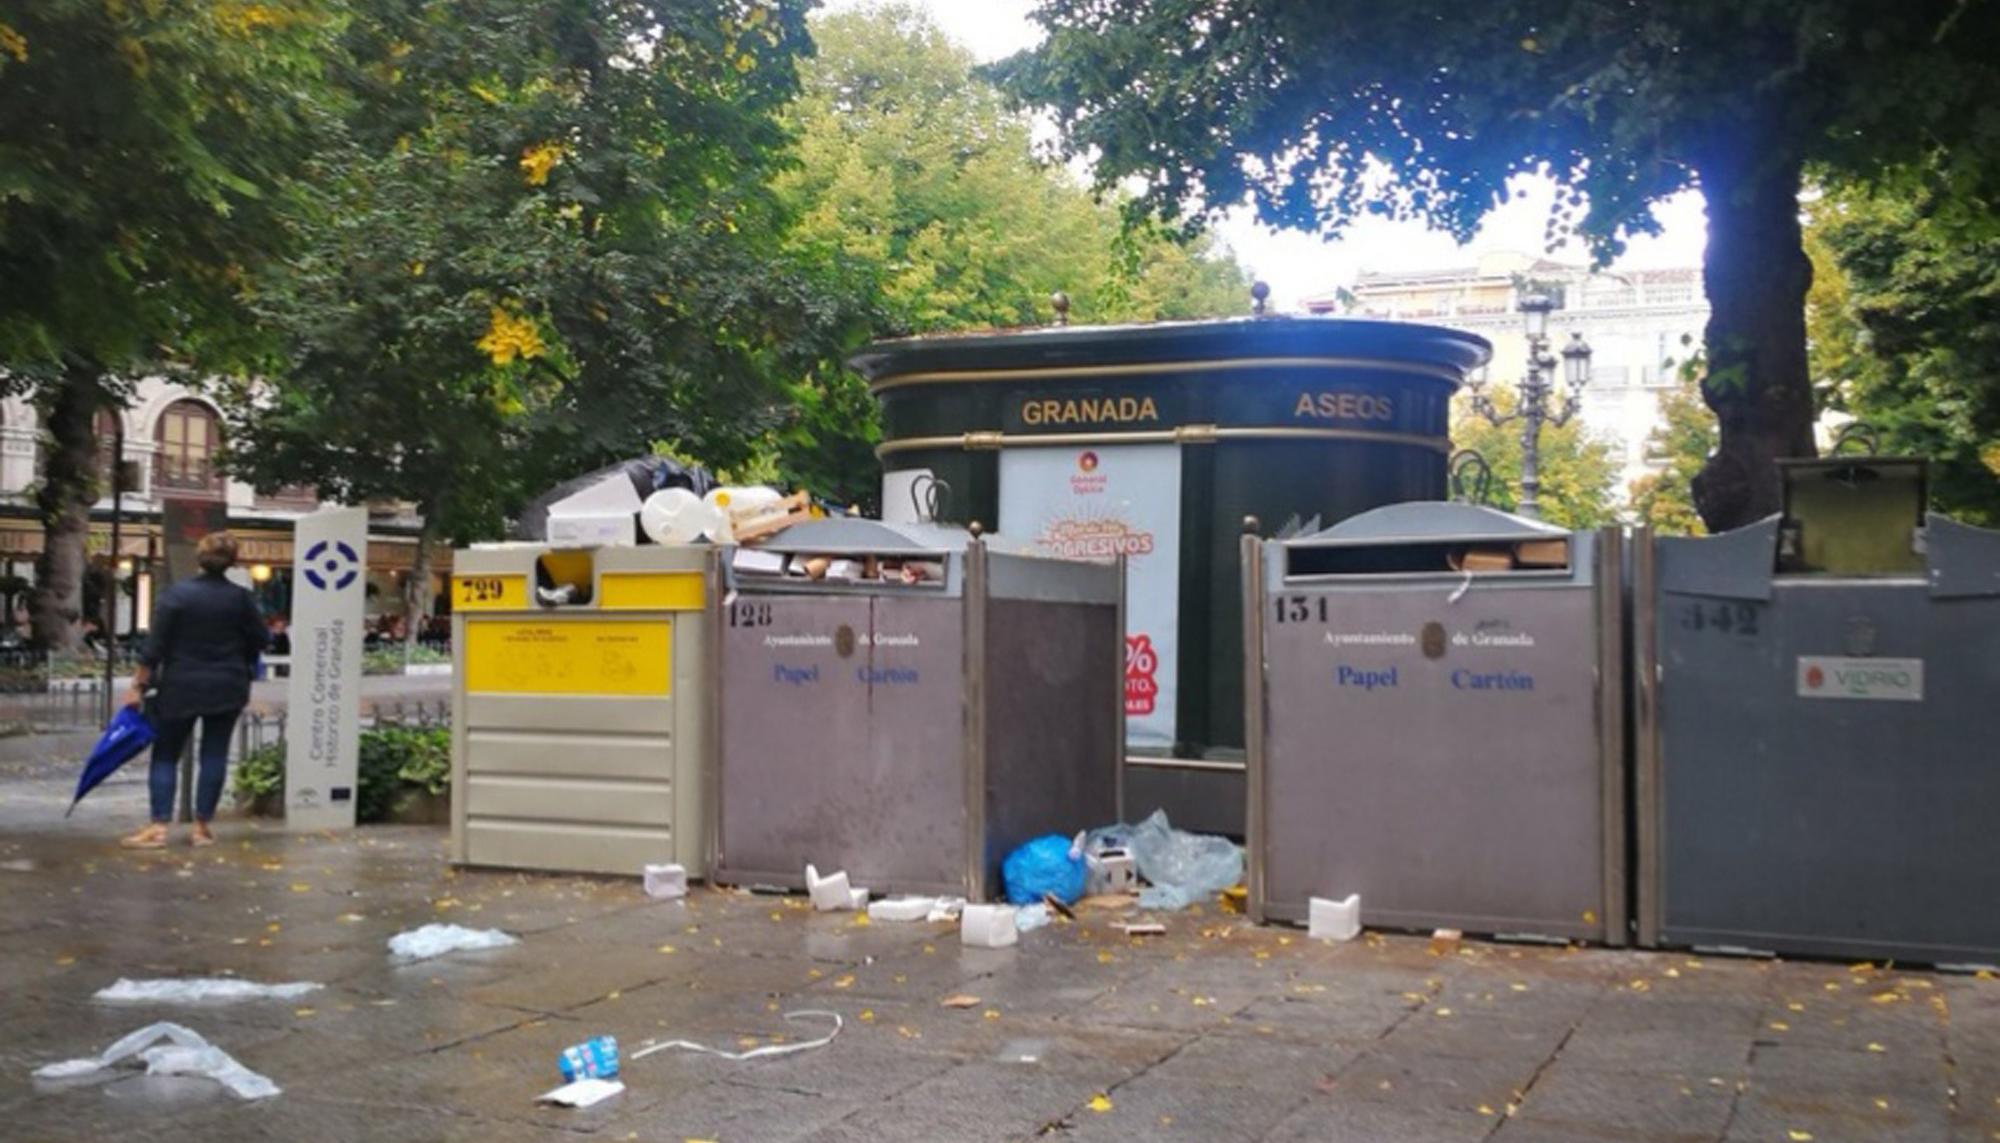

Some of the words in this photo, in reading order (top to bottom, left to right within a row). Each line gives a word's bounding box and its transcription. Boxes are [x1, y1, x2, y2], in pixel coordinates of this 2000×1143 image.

[1021, 397, 1158, 424] GRANADA
[1294, 393, 1392, 420] ASEOS
[462, 579, 503, 602] 729
[1275, 597, 1328, 622] 131
[764, 634, 832, 648] Ayuntamiento
[1324, 632, 1416, 648] Ayuntamiento
[1452, 632, 1469, 646] de
[1472, 633, 1535, 647] Granada
[311, 627, 328, 705] Comercial
[774, 663, 819, 688] Papel
[1337, 666, 1398, 690] Papel
[1452, 668, 1534, 690] Cartón
[309, 708, 325, 761] Centro
